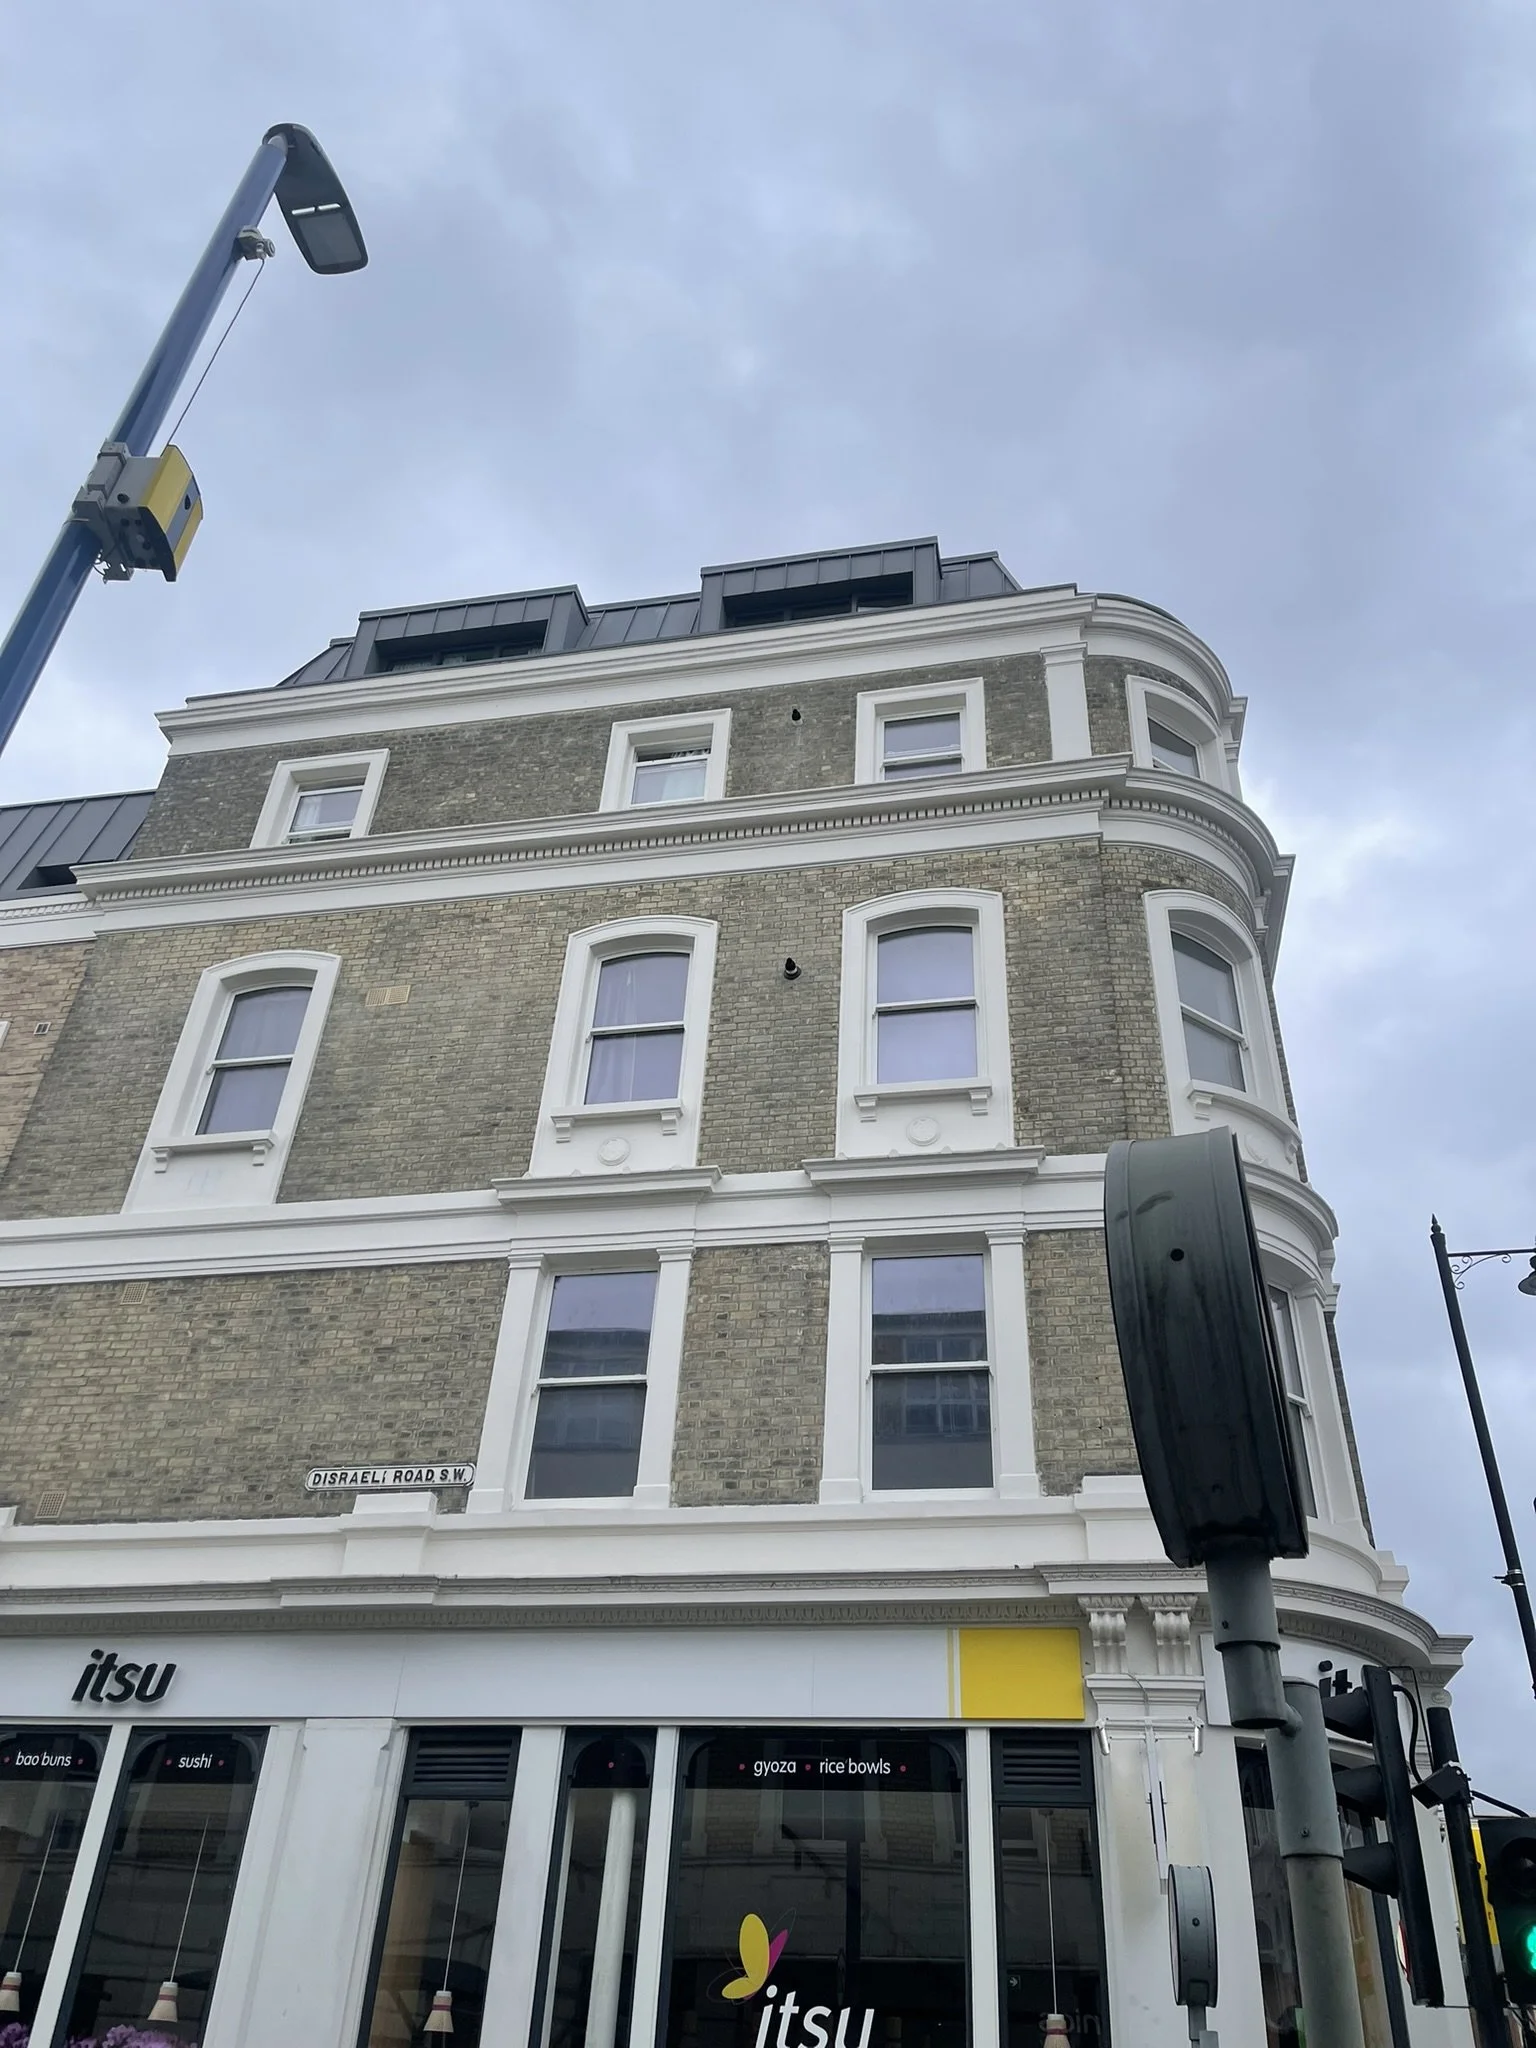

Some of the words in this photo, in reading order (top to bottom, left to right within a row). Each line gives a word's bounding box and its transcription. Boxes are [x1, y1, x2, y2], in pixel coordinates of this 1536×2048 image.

[312, 1470, 388, 1487] DISRAELI
[71, 1648, 177, 1703] itsu
[177, 1753, 213, 1769] sushi
[753, 1760, 797, 1777] gyoza
[754, 1984, 875, 2048] itsu
